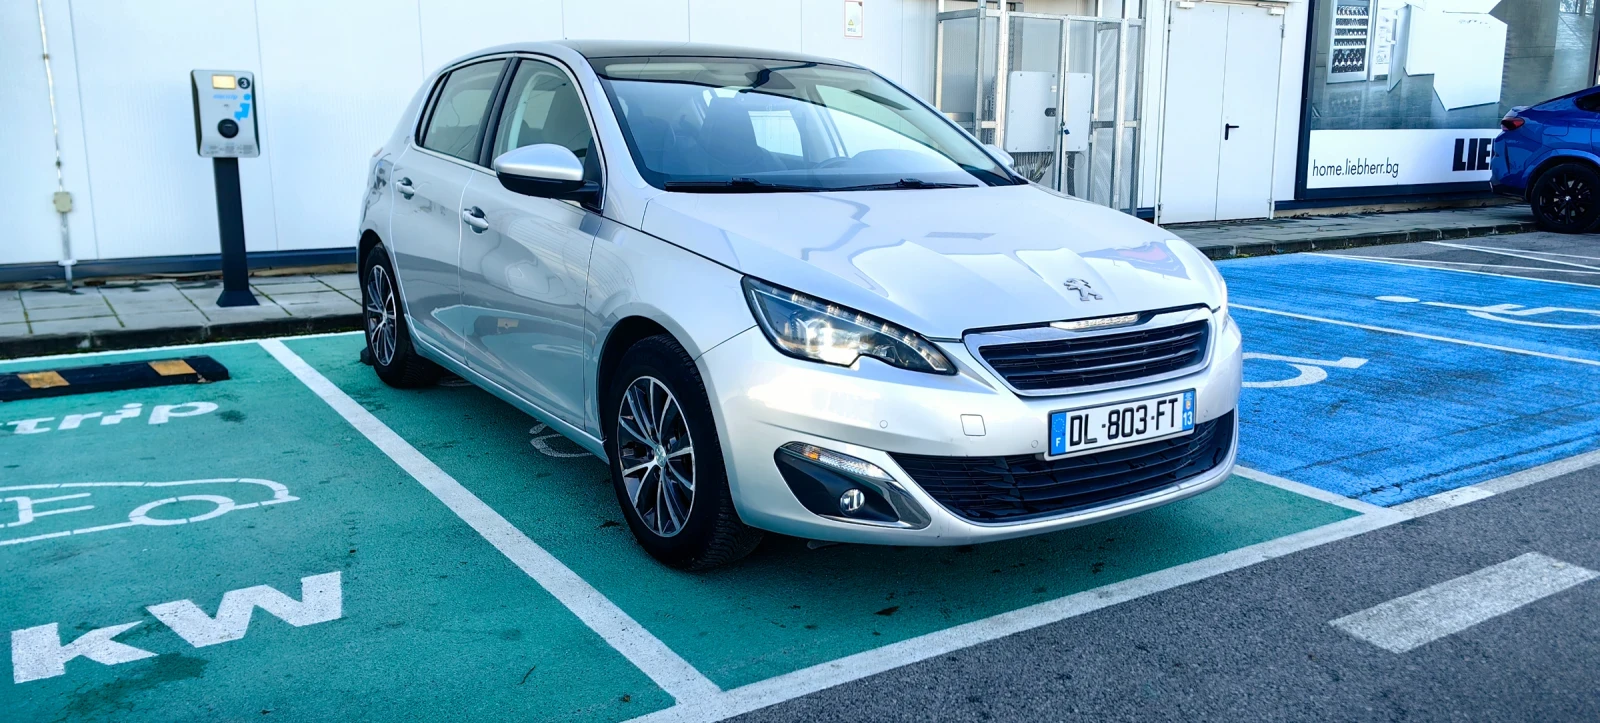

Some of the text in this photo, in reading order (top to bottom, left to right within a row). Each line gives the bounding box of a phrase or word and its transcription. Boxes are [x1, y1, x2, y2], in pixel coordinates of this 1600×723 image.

[241, 79, 248, 87] 3
[1312, 157, 1399, 178] home.liebherr.bg
[1452, 138, 1496, 171] LIE
[0, 402, 219, 434] trip
[1055, 437, 1062, 447] F
[1183, 411, 1193, 426] 13
